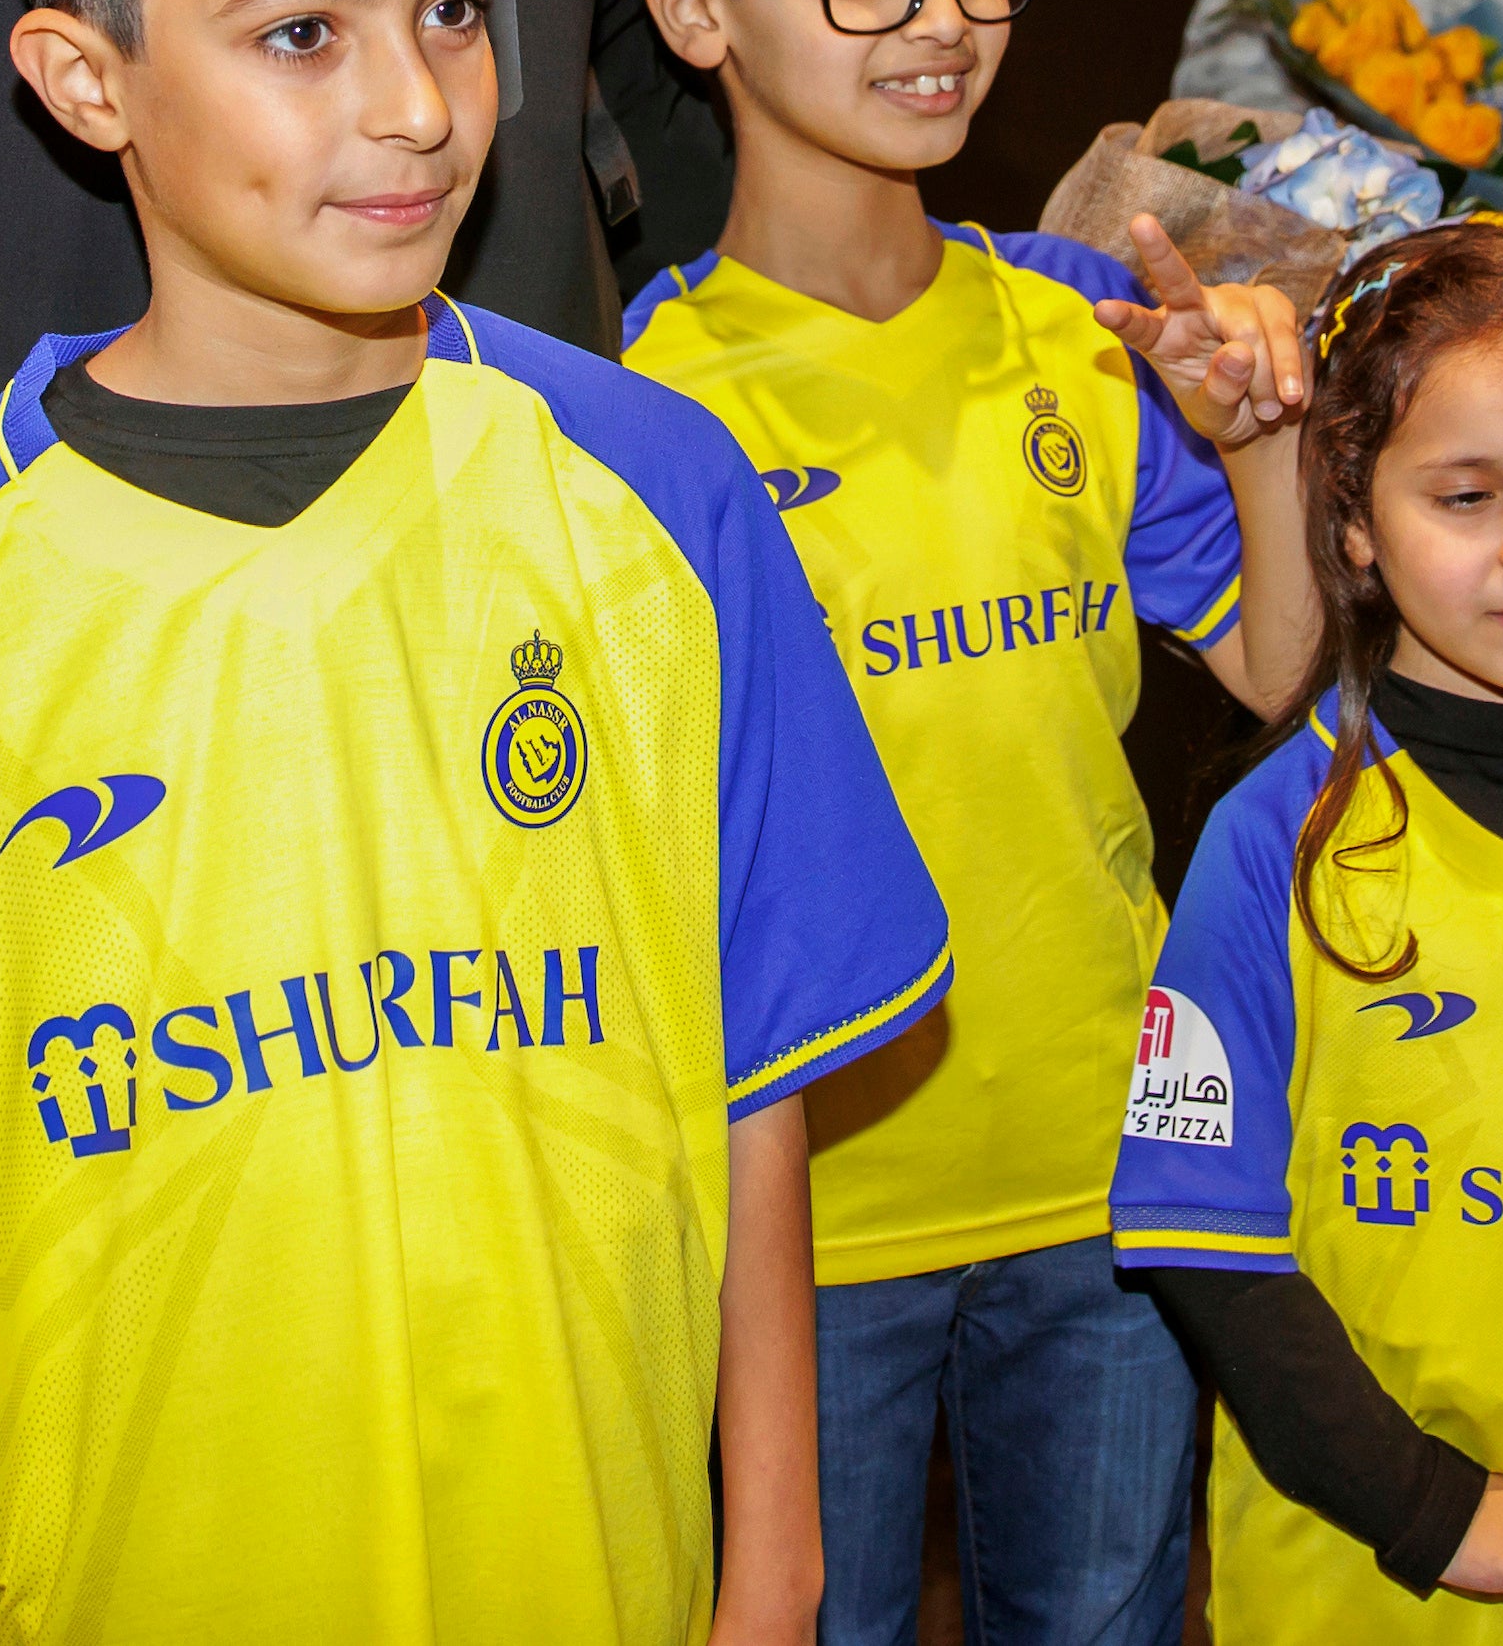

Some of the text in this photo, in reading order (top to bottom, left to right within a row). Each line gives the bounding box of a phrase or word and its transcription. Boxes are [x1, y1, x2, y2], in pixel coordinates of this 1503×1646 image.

[862, 581, 1119, 677] SHURFH
[507, 701, 569, 733] AL NASSR
[505, 775, 570, 810] FOOTBALL CLUB
[150, 944, 605, 1112] SHURFAH
[1133, 1068, 1228, 1110] هاريز
[1155, 1114, 1226, 1143] PIZZA
